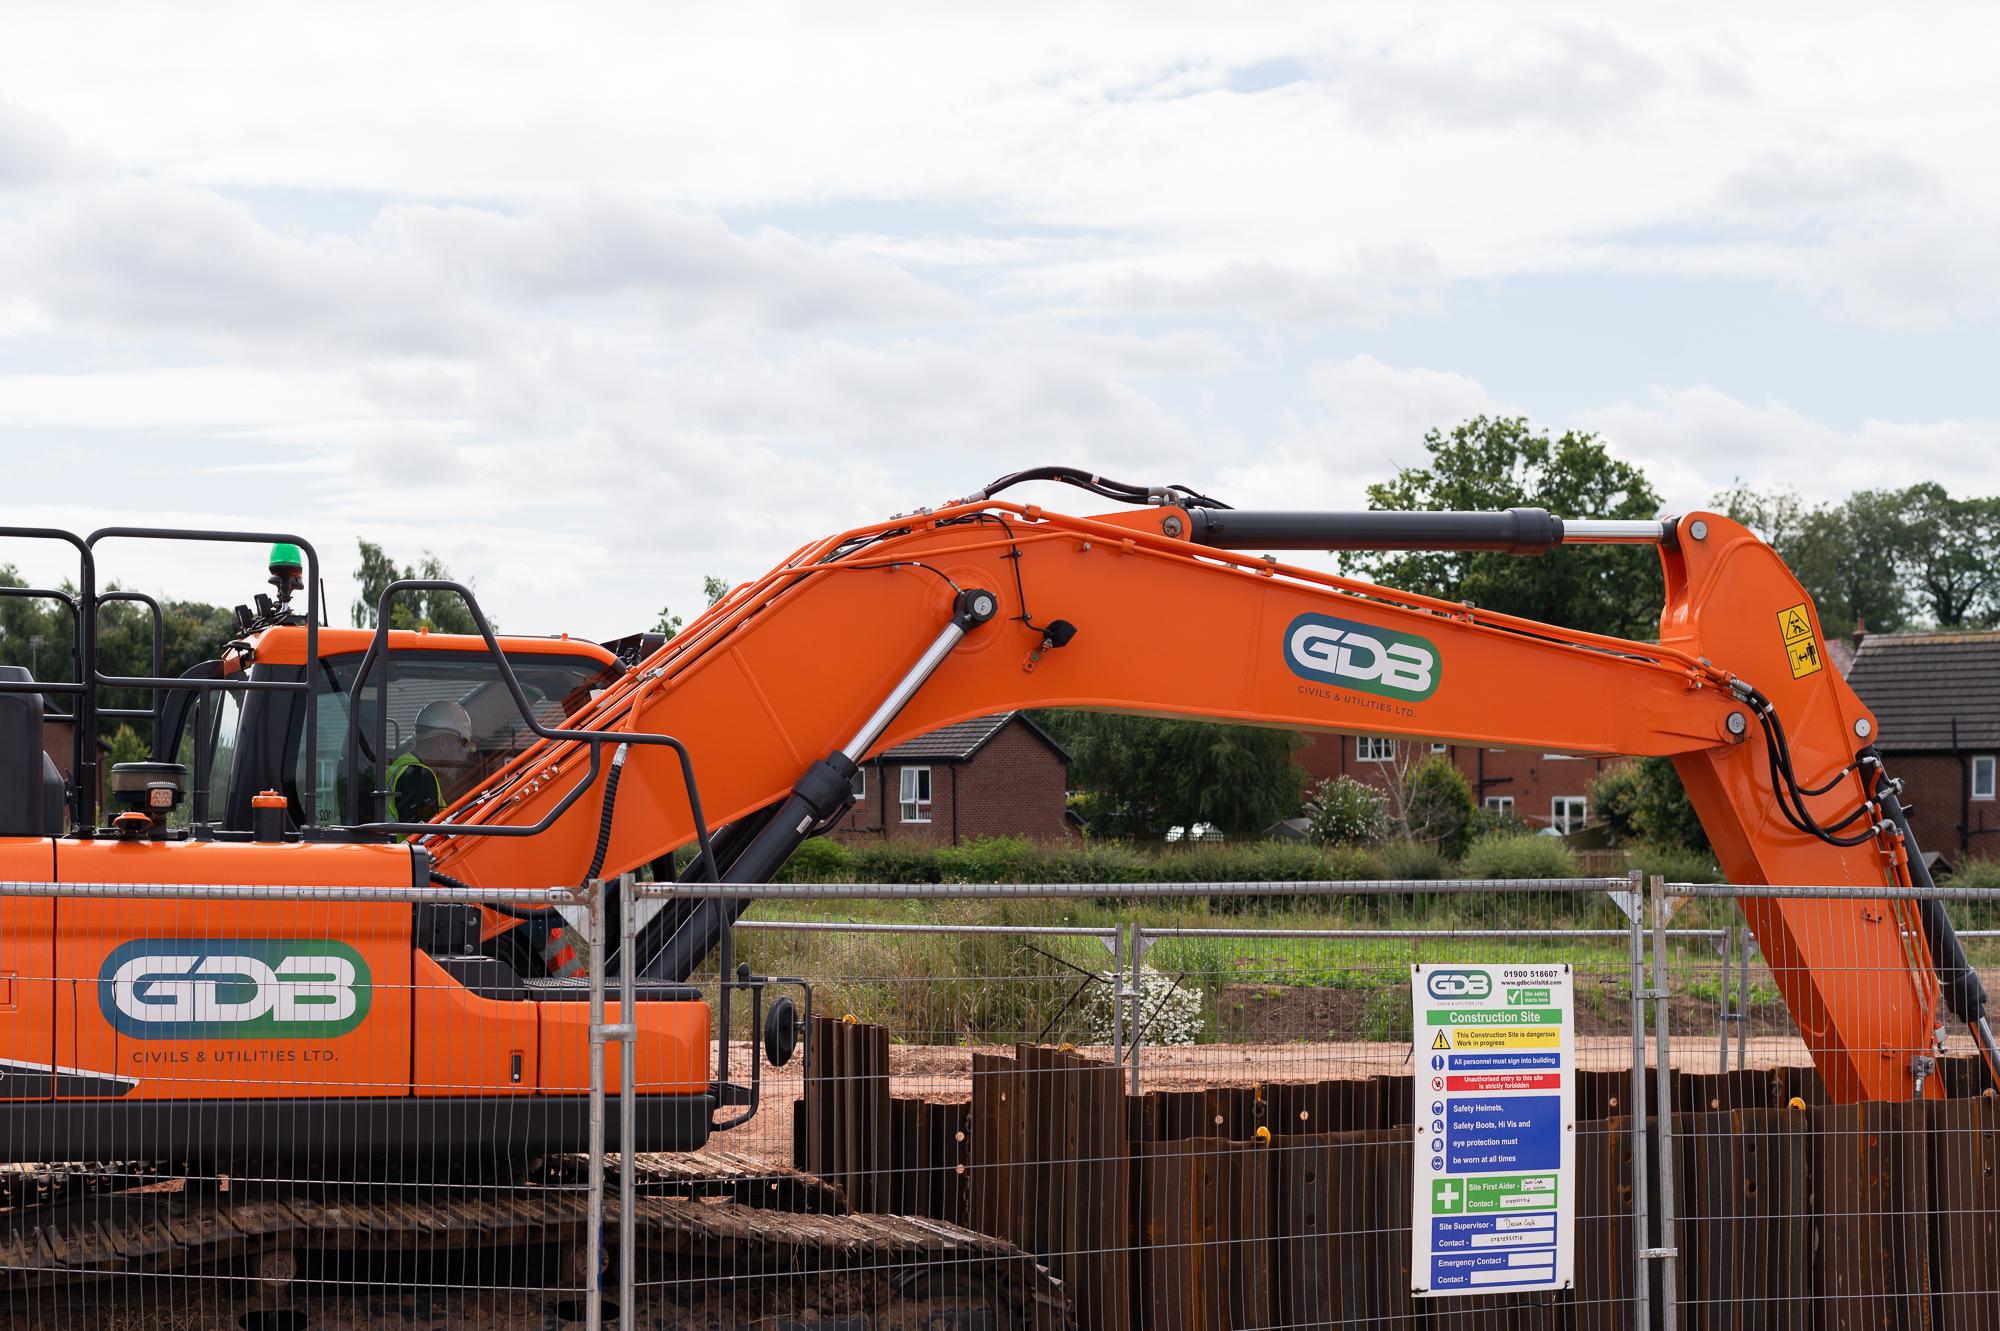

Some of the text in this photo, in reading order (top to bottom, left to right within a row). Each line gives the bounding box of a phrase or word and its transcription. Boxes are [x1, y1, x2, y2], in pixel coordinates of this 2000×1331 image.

[1291, 624, 1433, 691] GDB
[1297, 686, 1330, 699] CIVILS
[1344, 695, 1391, 712] UTILITIES
[1396, 706, 1416, 717] LTD.
[112, 956, 356, 1022] GDB
[1430, 975, 1489, 995] GDB
[1450, 1012, 1540, 1022] Construction Site
[1526, 1031, 1555, 1039] dangerous
[133, 1050, 338, 1063] CIVILS & UTILITIES LTD.
[1453, 1105, 1474, 1113] Safety
[1453, 1122, 1474, 1130] Safety
[1467, 1139, 1499, 1147] protection
[1454, 1222, 1489, 1230] Supervisor
[1439, 1259, 1475, 1268] Emergency
